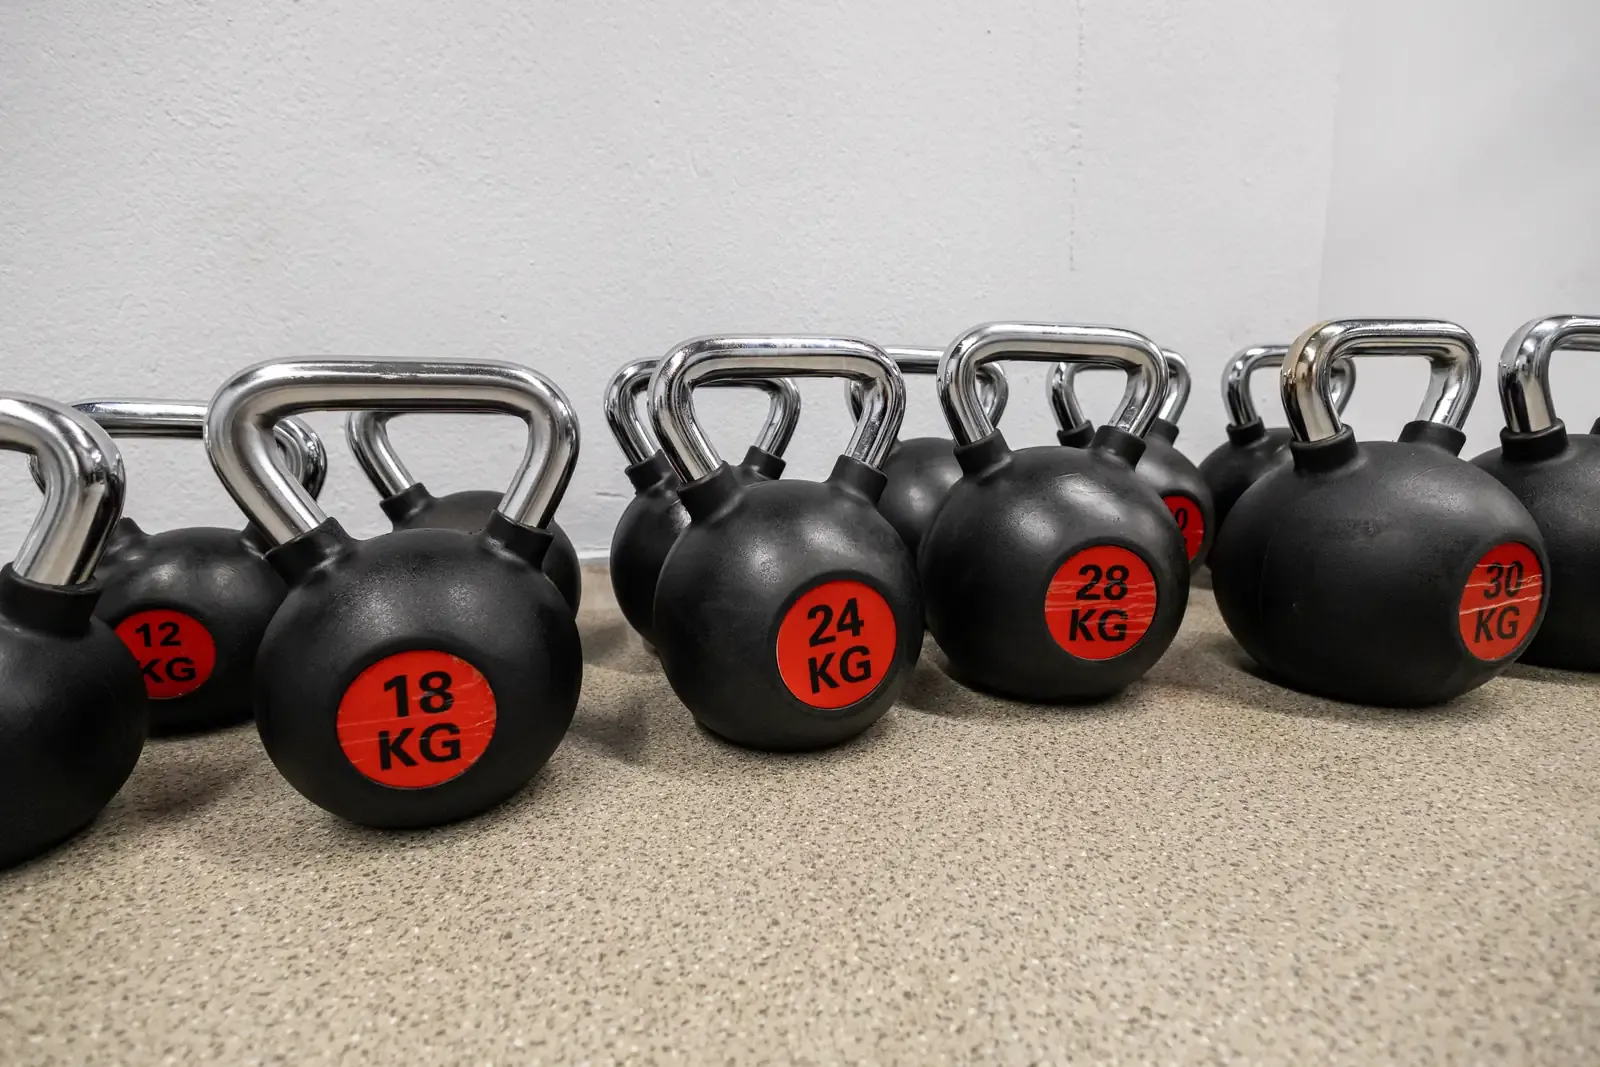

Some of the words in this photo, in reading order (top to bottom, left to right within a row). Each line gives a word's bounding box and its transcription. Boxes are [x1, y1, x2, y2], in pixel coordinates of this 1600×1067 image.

[1169, 507, 1188, 531] 0
[1076, 564, 1129, 600] 28
[1484, 561, 1524, 599] 30
[135, 621, 182, 648] 12
[807, 597, 865, 648] 24
[1069, 608, 1128, 642] KG
[1474, 605, 1520, 643] KG
[140, 656, 197, 684] KG
[808, 645, 872, 694] KG
[384, 670, 455, 718] 18
[378, 722, 461, 771] KG
